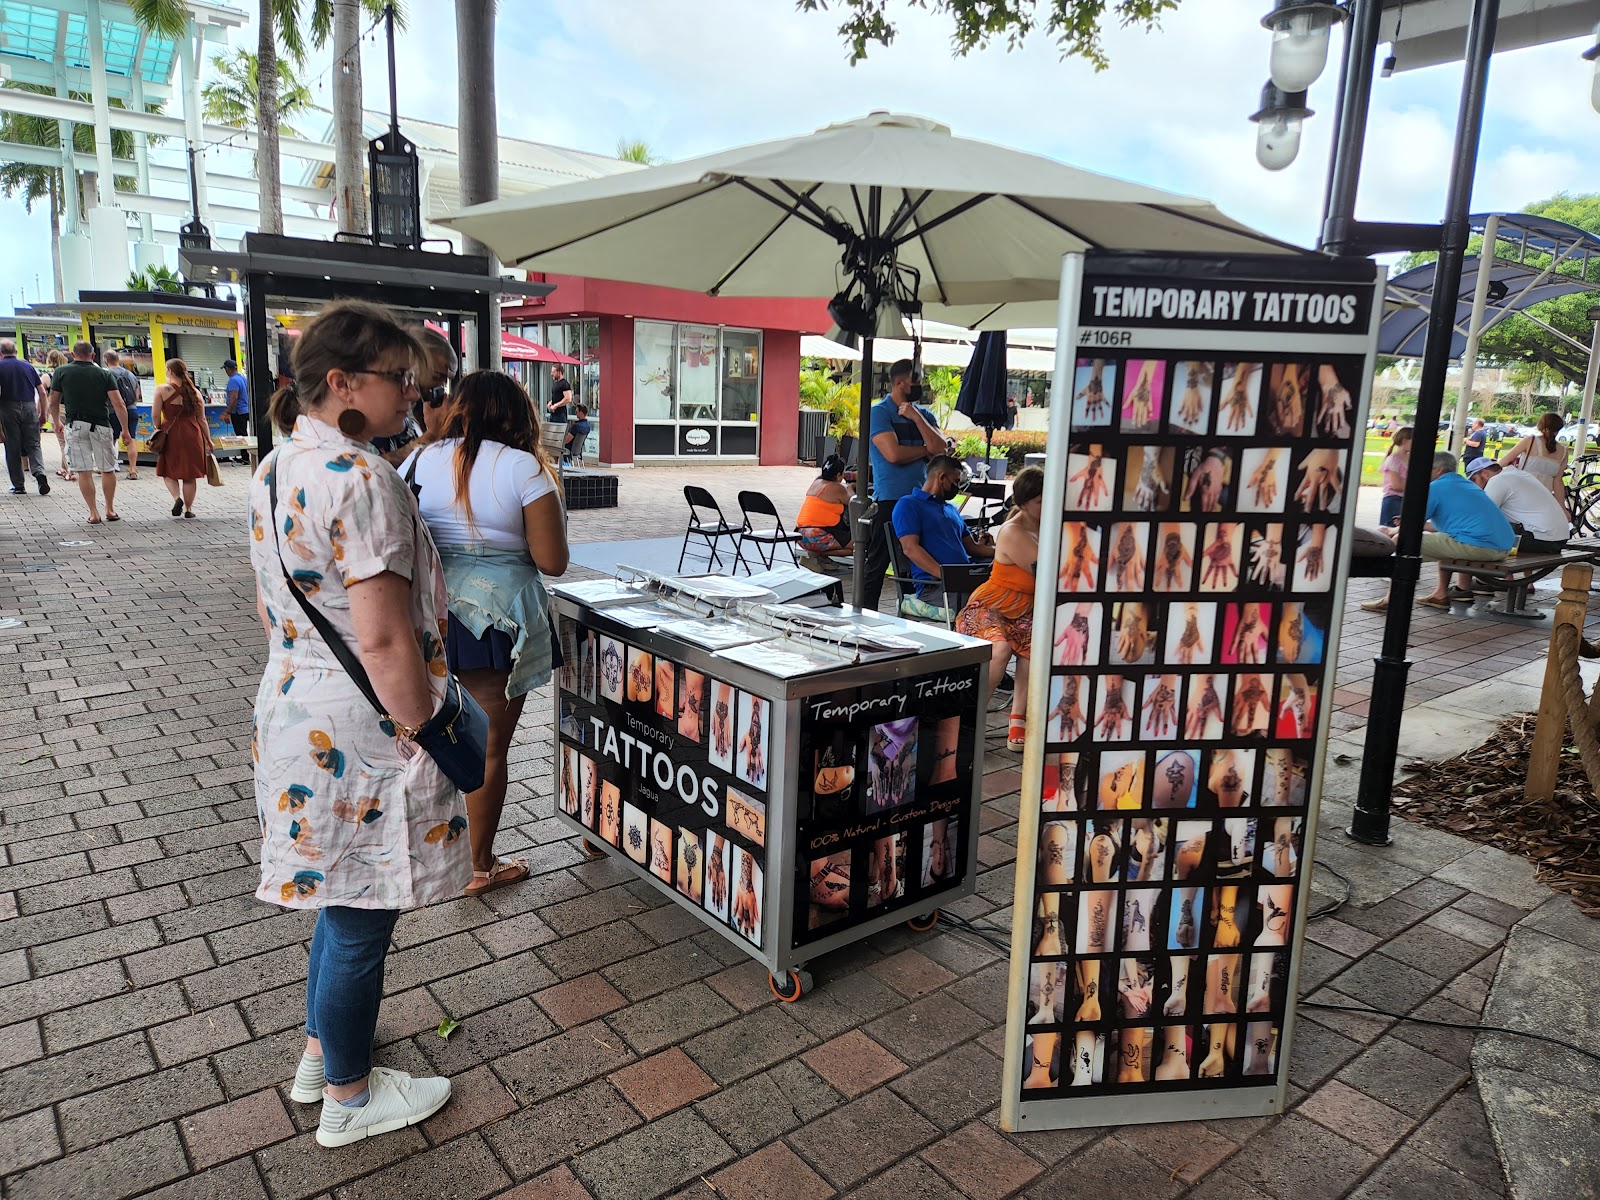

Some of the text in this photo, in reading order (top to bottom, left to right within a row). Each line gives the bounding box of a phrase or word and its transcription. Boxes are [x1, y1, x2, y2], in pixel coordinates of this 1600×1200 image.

[97, 311, 113, 320] Just
[177, 317, 194, 327] Just
[1092, 285, 1357, 324] TEMPORARY TATTOOS
[1079, 330, 1132, 346] #106R
[811, 676, 973, 722] Temporary Tattoos
[625, 711, 675, 750] Temporary
[590, 715, 719, 818] TATTOOS
[638, 782, 659, 803] Jagua
[810, 832, 840, 850] 100%
[843, 818, 880, 838] Natural
[890, 808, 927, 825] Custom
[929, 797, 961, 813] Designs
